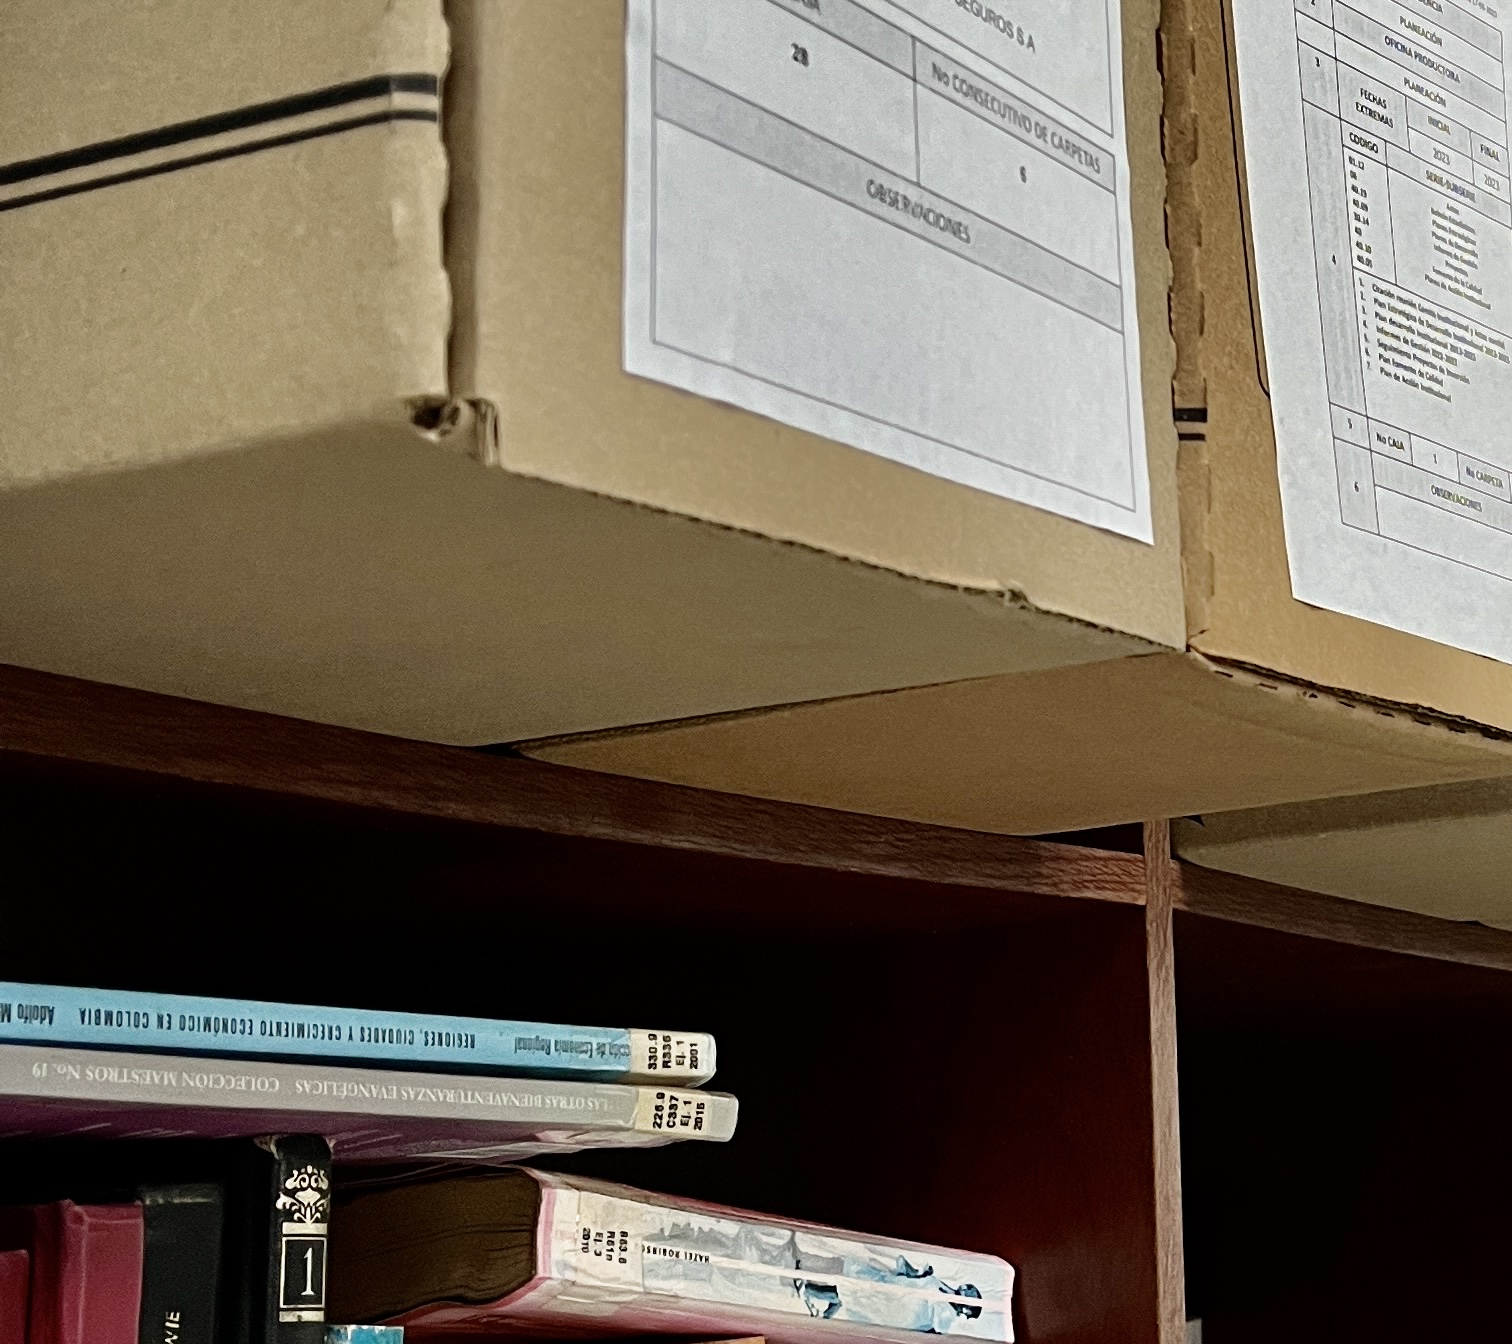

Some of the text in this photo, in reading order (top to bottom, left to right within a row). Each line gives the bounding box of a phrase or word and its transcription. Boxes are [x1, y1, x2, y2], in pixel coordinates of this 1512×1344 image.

[1359, 85, 1387, 111] FECHAS
[931, 63, 1101, 174] No CONSECUTIVO DE CARPETAS
[1355, 99, 1393, 129] EXTREMAS
[17, 1003, 55, 1026] Adolfo
[79, 1008, 149, 1028] COLOMBIA
[156, 1012, 171, 1026] EN
[259, 1020, 342, 1040] CRECIMIENTO
[347, 1026, 354, 1042] Y
[359, 1026, 414, 1046] CIUDADES
[32, 1061, 48, 1079] 19
[85, 1066, 177, 1087] MAESTROS
[182, 1072, 280, 1095] COLECCIÓN
[545, 1095, 584, 1109] OTRAS
[301, 1247, 315, 1295] 1
